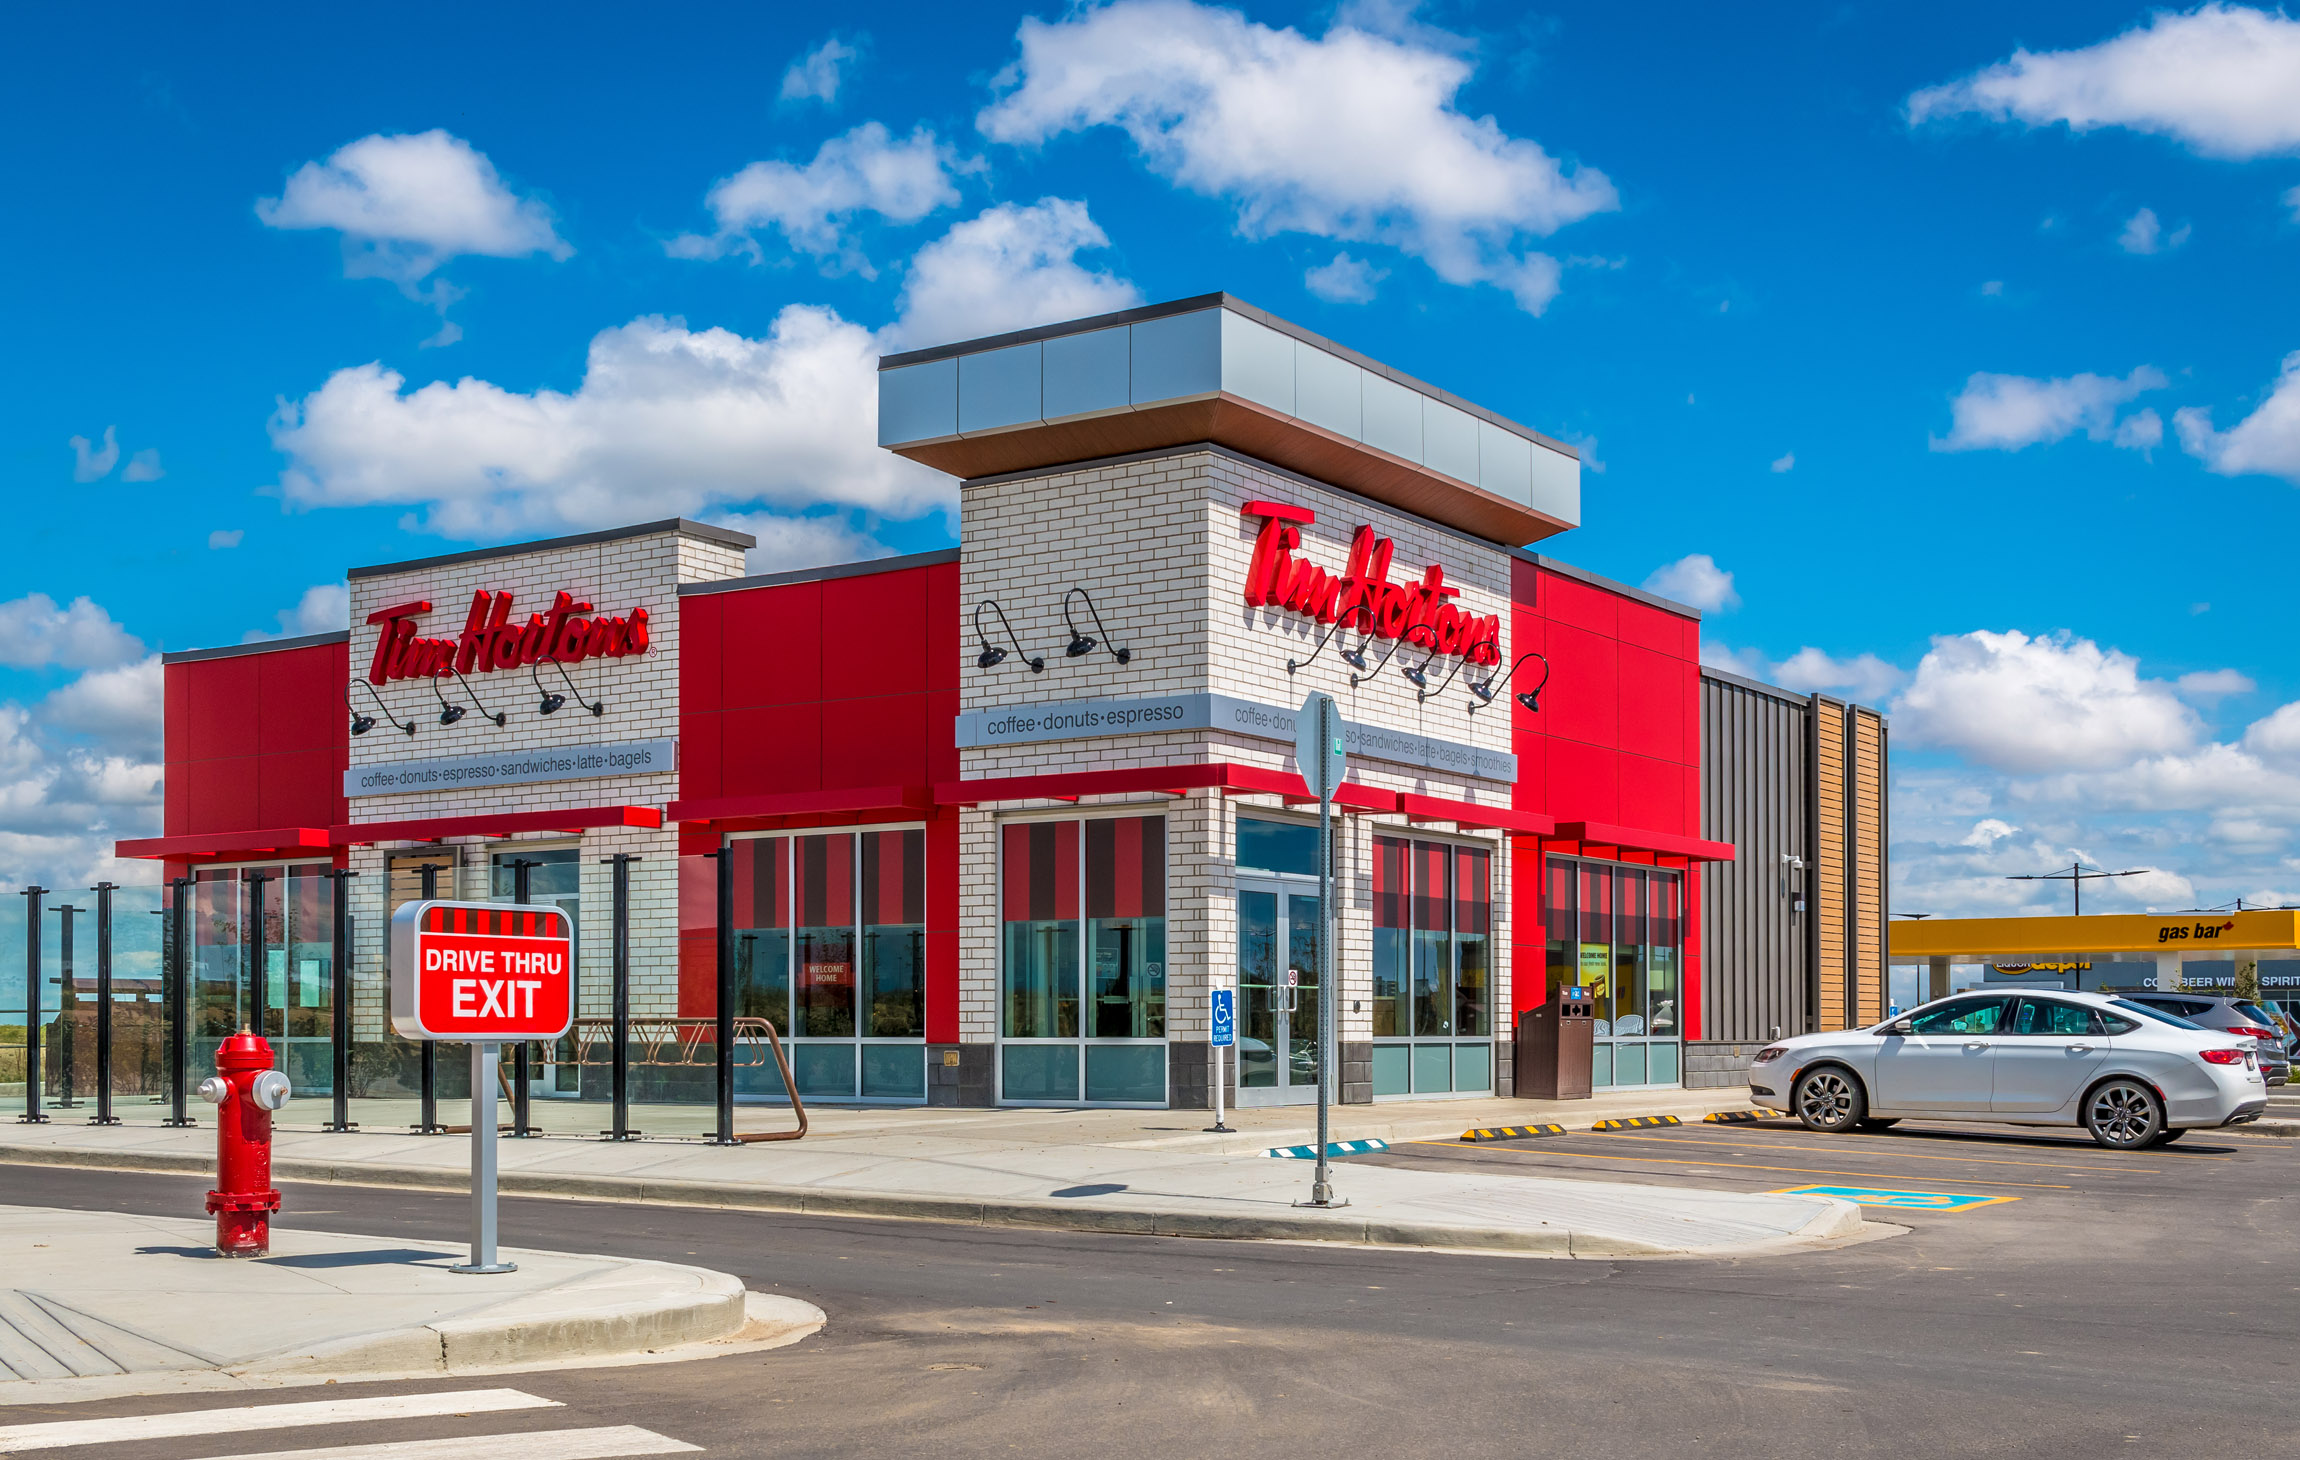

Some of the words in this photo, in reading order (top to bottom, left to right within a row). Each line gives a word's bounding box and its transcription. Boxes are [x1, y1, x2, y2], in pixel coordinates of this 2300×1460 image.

[1240, 500, 1342, 624] Tim
[1335, 524, 1500, 666] Hortons
[366, 600, 458, 686] Tim
[455, 589, 649, 675] Hortons
[987, 715, 1035, 735] coffee
[1043, 710, 1099, 730] donuts
[1107, 705, 1184, 728] espresso
[1235, 706, 1268, 727] coffee
[1273, 712, 1297, 733] donu
[361, 772, 394, 788] coffee
[400, 769, 438, 785] donuts
[443, 765, 495, 783] espresso
[501, 757, 572, 776] sandwiches
[577, 754, 603, 770] latte
[609, 748, 652, 769] bagels
[1440, 743, 1467, 767] bagels
[2158, 926, 2190, 943] gas
[2193, 922, 2223, 939] bar
[426, 949, 495, 973] DRIVE
[501, 951, 562, 975] THRU
[809, 965, 844, 973] WELCOME
[815, 974, 837, 982] HOME
[2181, 977, 2213, 987] BEER
[452, 978, 542, 1018] EXIT
[1215, 1025, 1230, 1033] PERMIT
